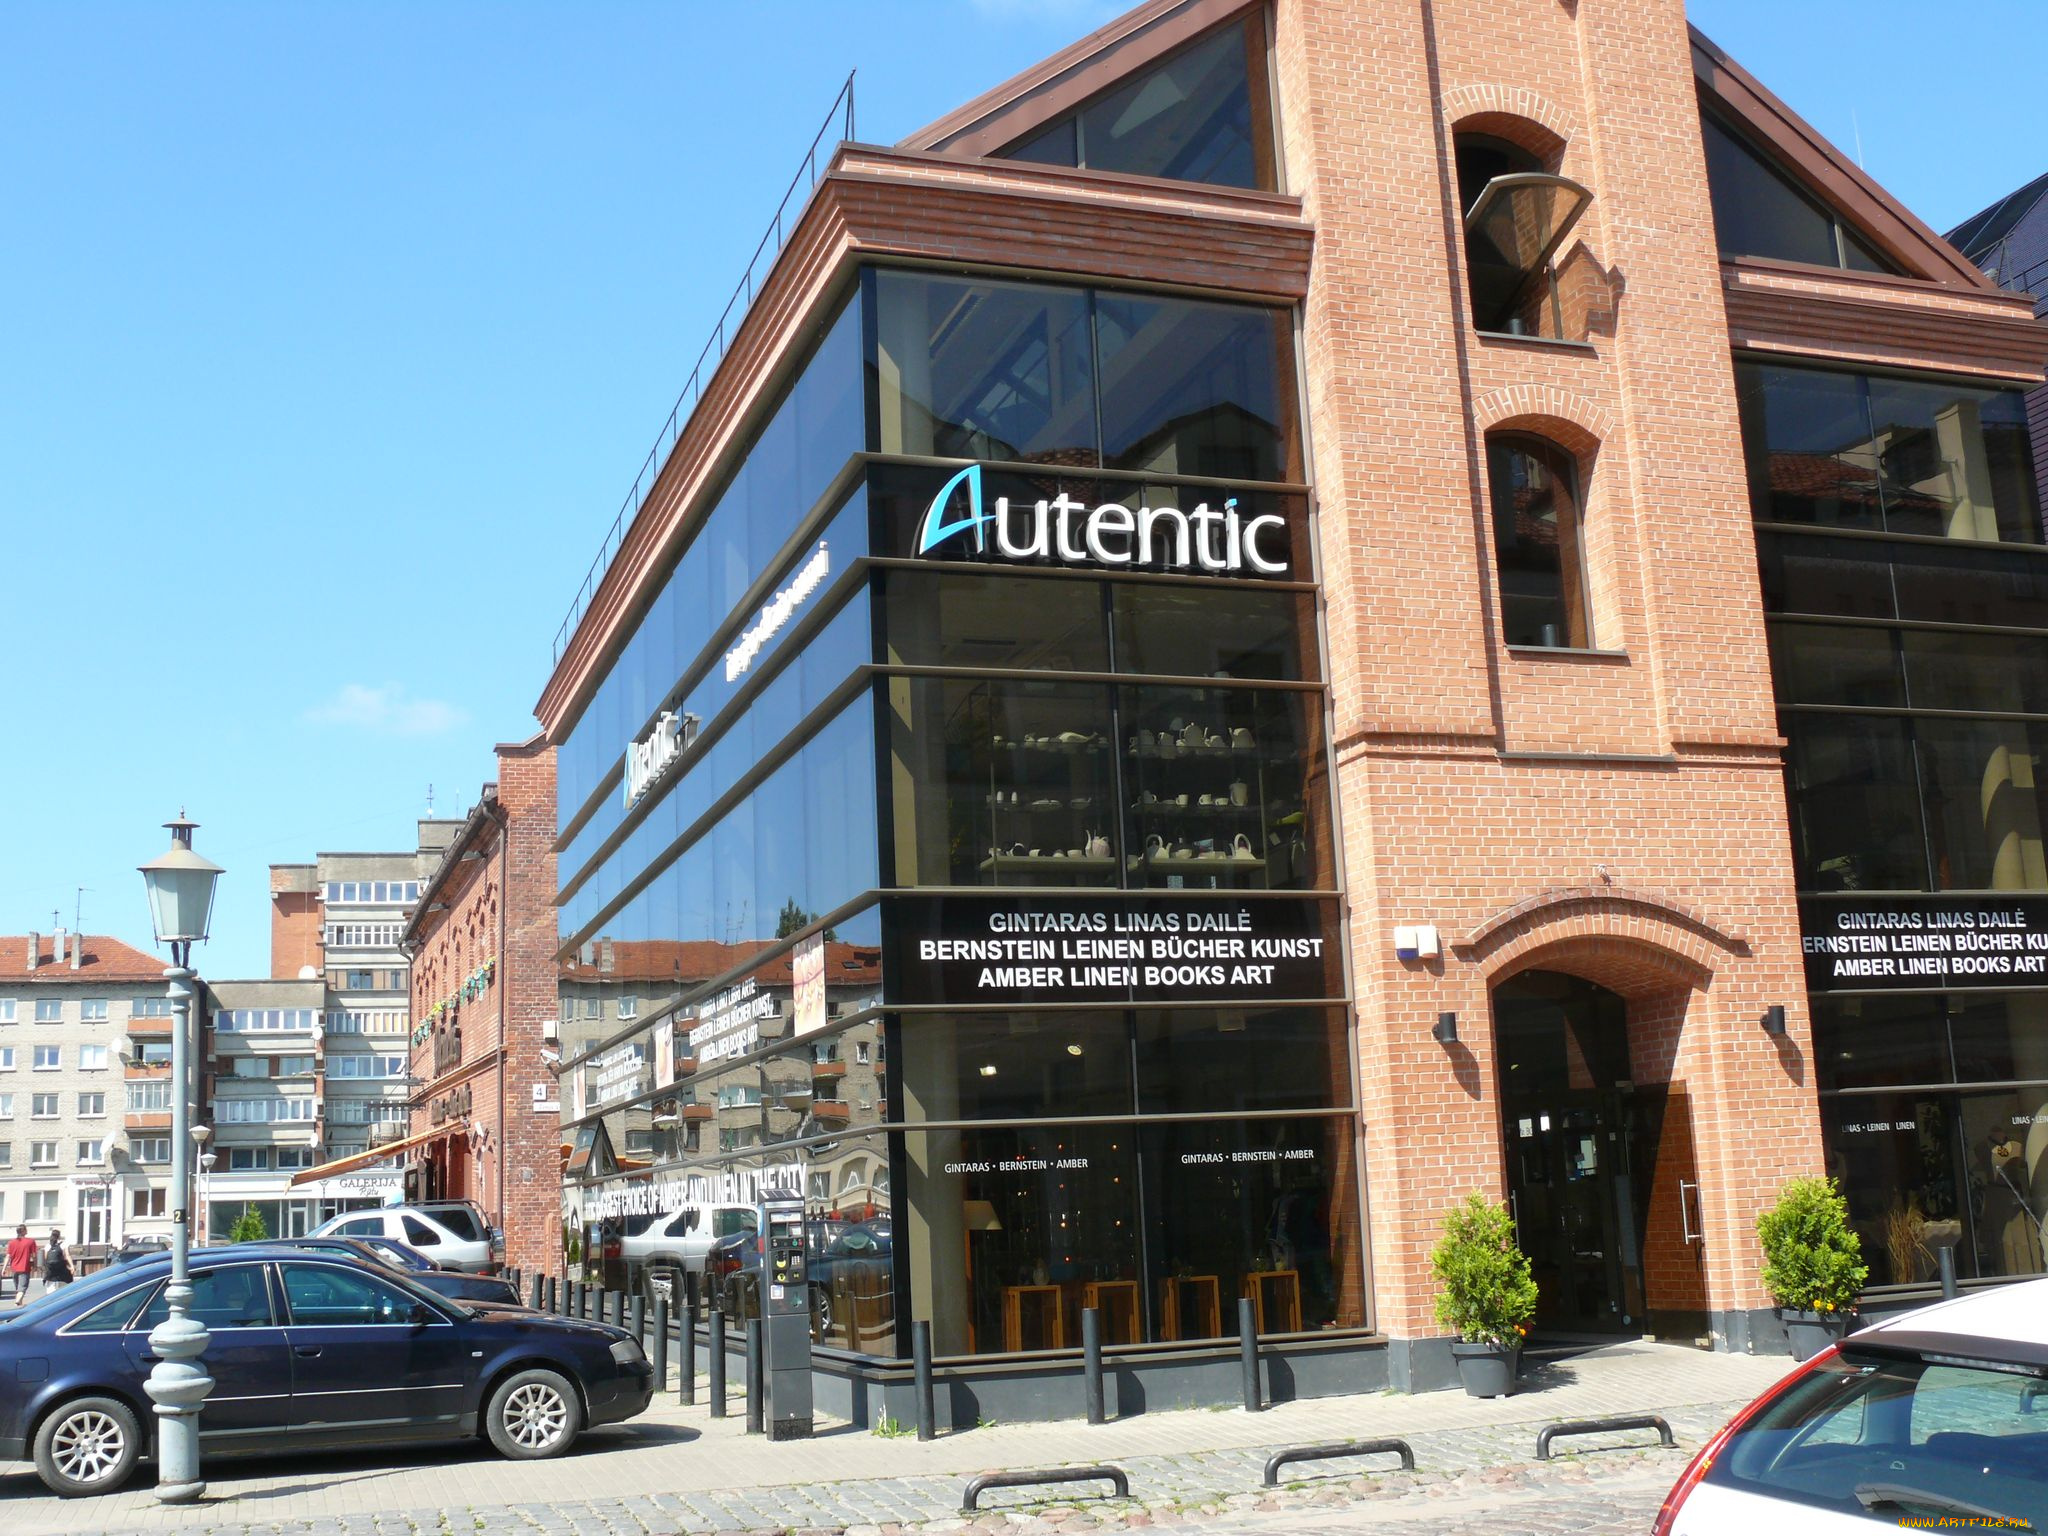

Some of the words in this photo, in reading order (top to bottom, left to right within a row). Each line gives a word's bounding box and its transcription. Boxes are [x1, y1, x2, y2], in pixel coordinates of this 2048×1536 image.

[919, 464, 1288, 573] Autentic
[988, 912, 1107, 933] GINTARAS
[1113, 912, 1182, 932] LINAS
[1187, 907, 1252, 932] DAILĖ
[1837, 913, 1922, 930] GINTARAS
[1926, 912, 1975, 928] LINAS
[1978, 908, 2027, 928] DAILĖ
[919, 940, 1056, 960] BERNSTEIN
[1062, 940, 1145, 959] LEINEN
[1151, 936, 1245, 958] BÜCHER
[1251, 938, 1324, 958] KUNST
[1802, 936, 1887, 953] ERNSTEIN
[1891, 935, 1951, 951] LEINEN
[1954, 931, 2024, 951] BÜCHER
[2026, 934, 2048, 950] KU
[977, 967, 1064, 988] AMBER
[1070, 967, 1138, 986] LINEN
[1145, 966, 1225, 986] BOOKS
[1230, 965, 1275, 984] ART
[1833, 959, 1896, 976] AMBER
[1899, 958, 1948, 974] LINEN
[1952, 956, 2011, 974] BOOKS
[2013, 956, 2046, 972] ART
[536, 1087, 543, 1096] 4
[1866, 1122, 1889, 1132] LEINEN
[1896, 1121, 1915, 1130] LINEN
[944, 1162, 990, 1174] GINTARAS
[999, 1160, 1047, 1172] BERNSTEIN
[1056, 1158, 1089, 1169] AMBER
[1181, 1153, 1224, 1164] GINTARAS
[1231, 1151, 1277, 1162] BERNSTEIN
[1284, 1149, 1315, 1160] AMBER
[340, 1178, 397, 1188] GALERIJA
[622, 1186, 647, 1216] CHOICE
[648, 1184, 659, 1214] OF
[659, 1179, 688, 1212] AMBER
[739, 1171, 751, 1205] IN
[175, 1211, 181, 1222] 2
